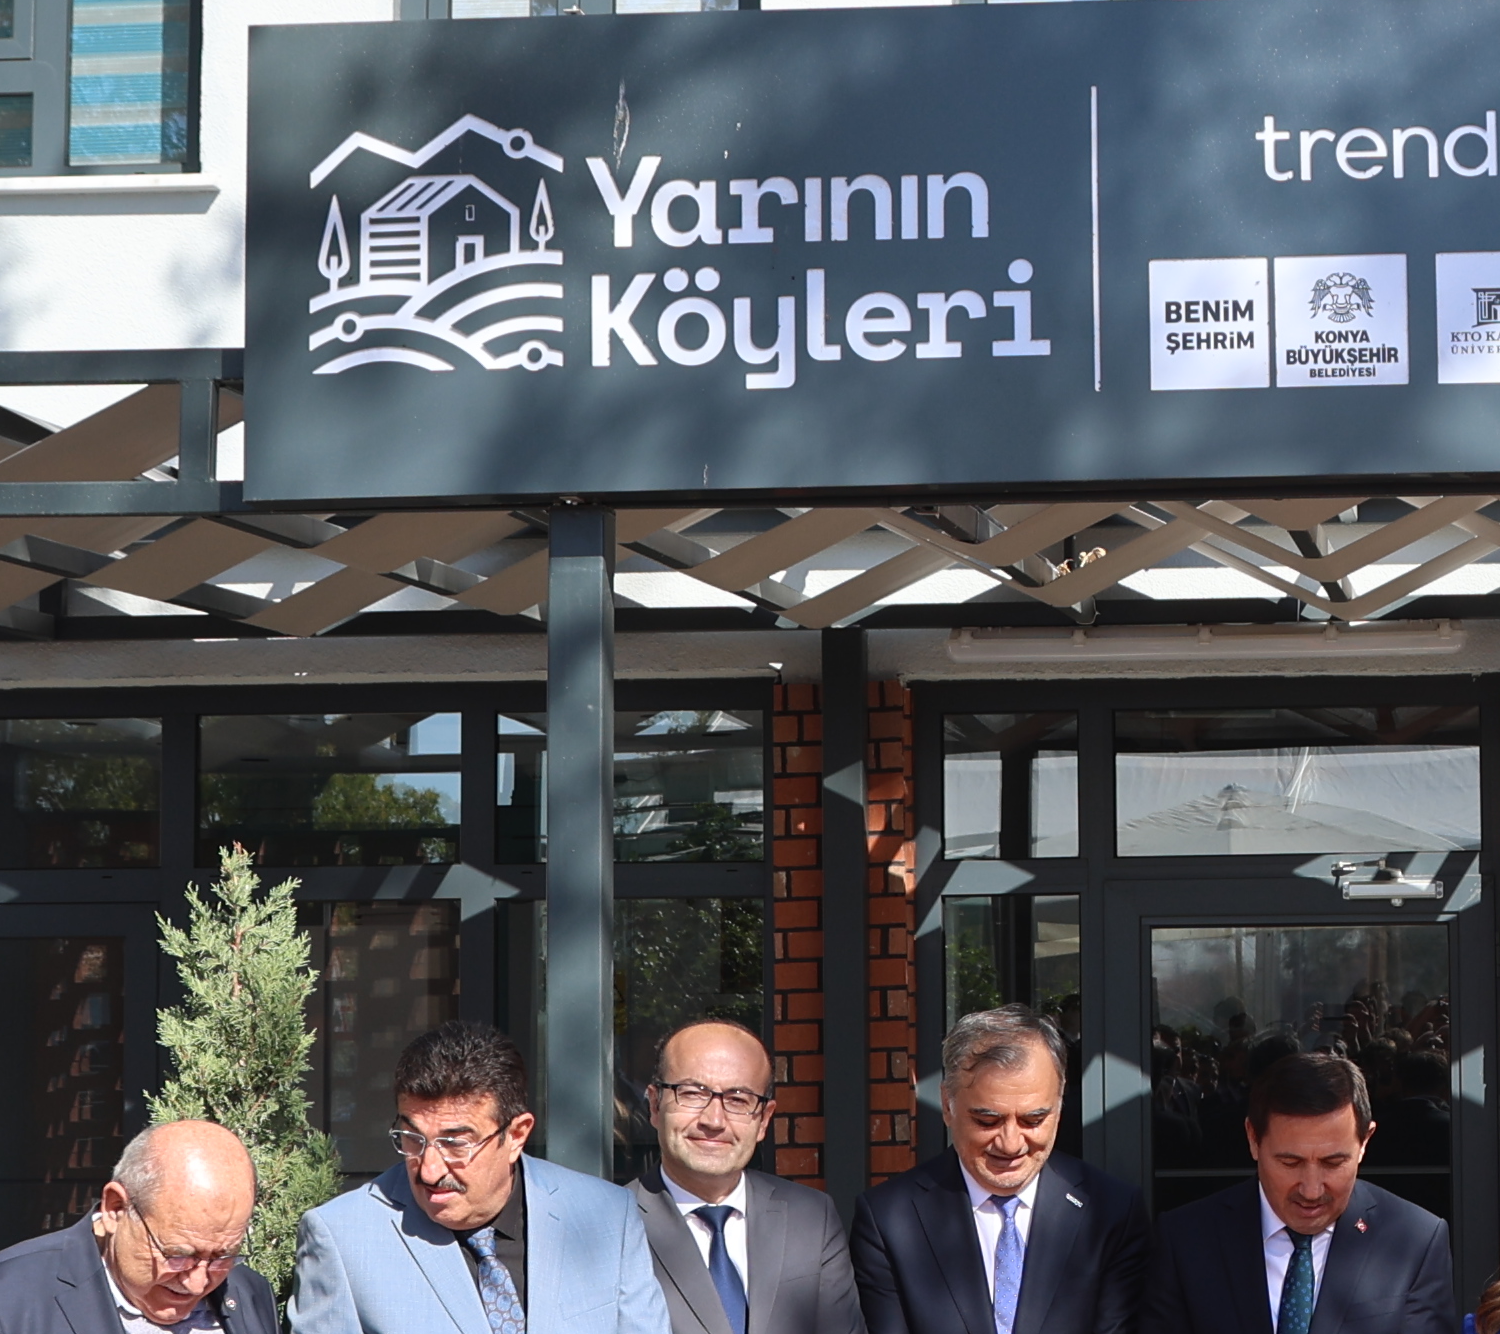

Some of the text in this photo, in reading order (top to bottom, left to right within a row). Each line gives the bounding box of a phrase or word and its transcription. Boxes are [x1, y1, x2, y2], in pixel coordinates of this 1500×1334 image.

[585, 156, 989, 247] Yarının
[591, 258, 1051, 389] Köyleri
[1314, 330, 1370, 344] KONYA
[1450, 331, 1482, 342] KTO
[1286, 344, 1399, 366] BÜYÜKŞEHİR
[1309, 365, 1376, 378] BELEDİYESİ
